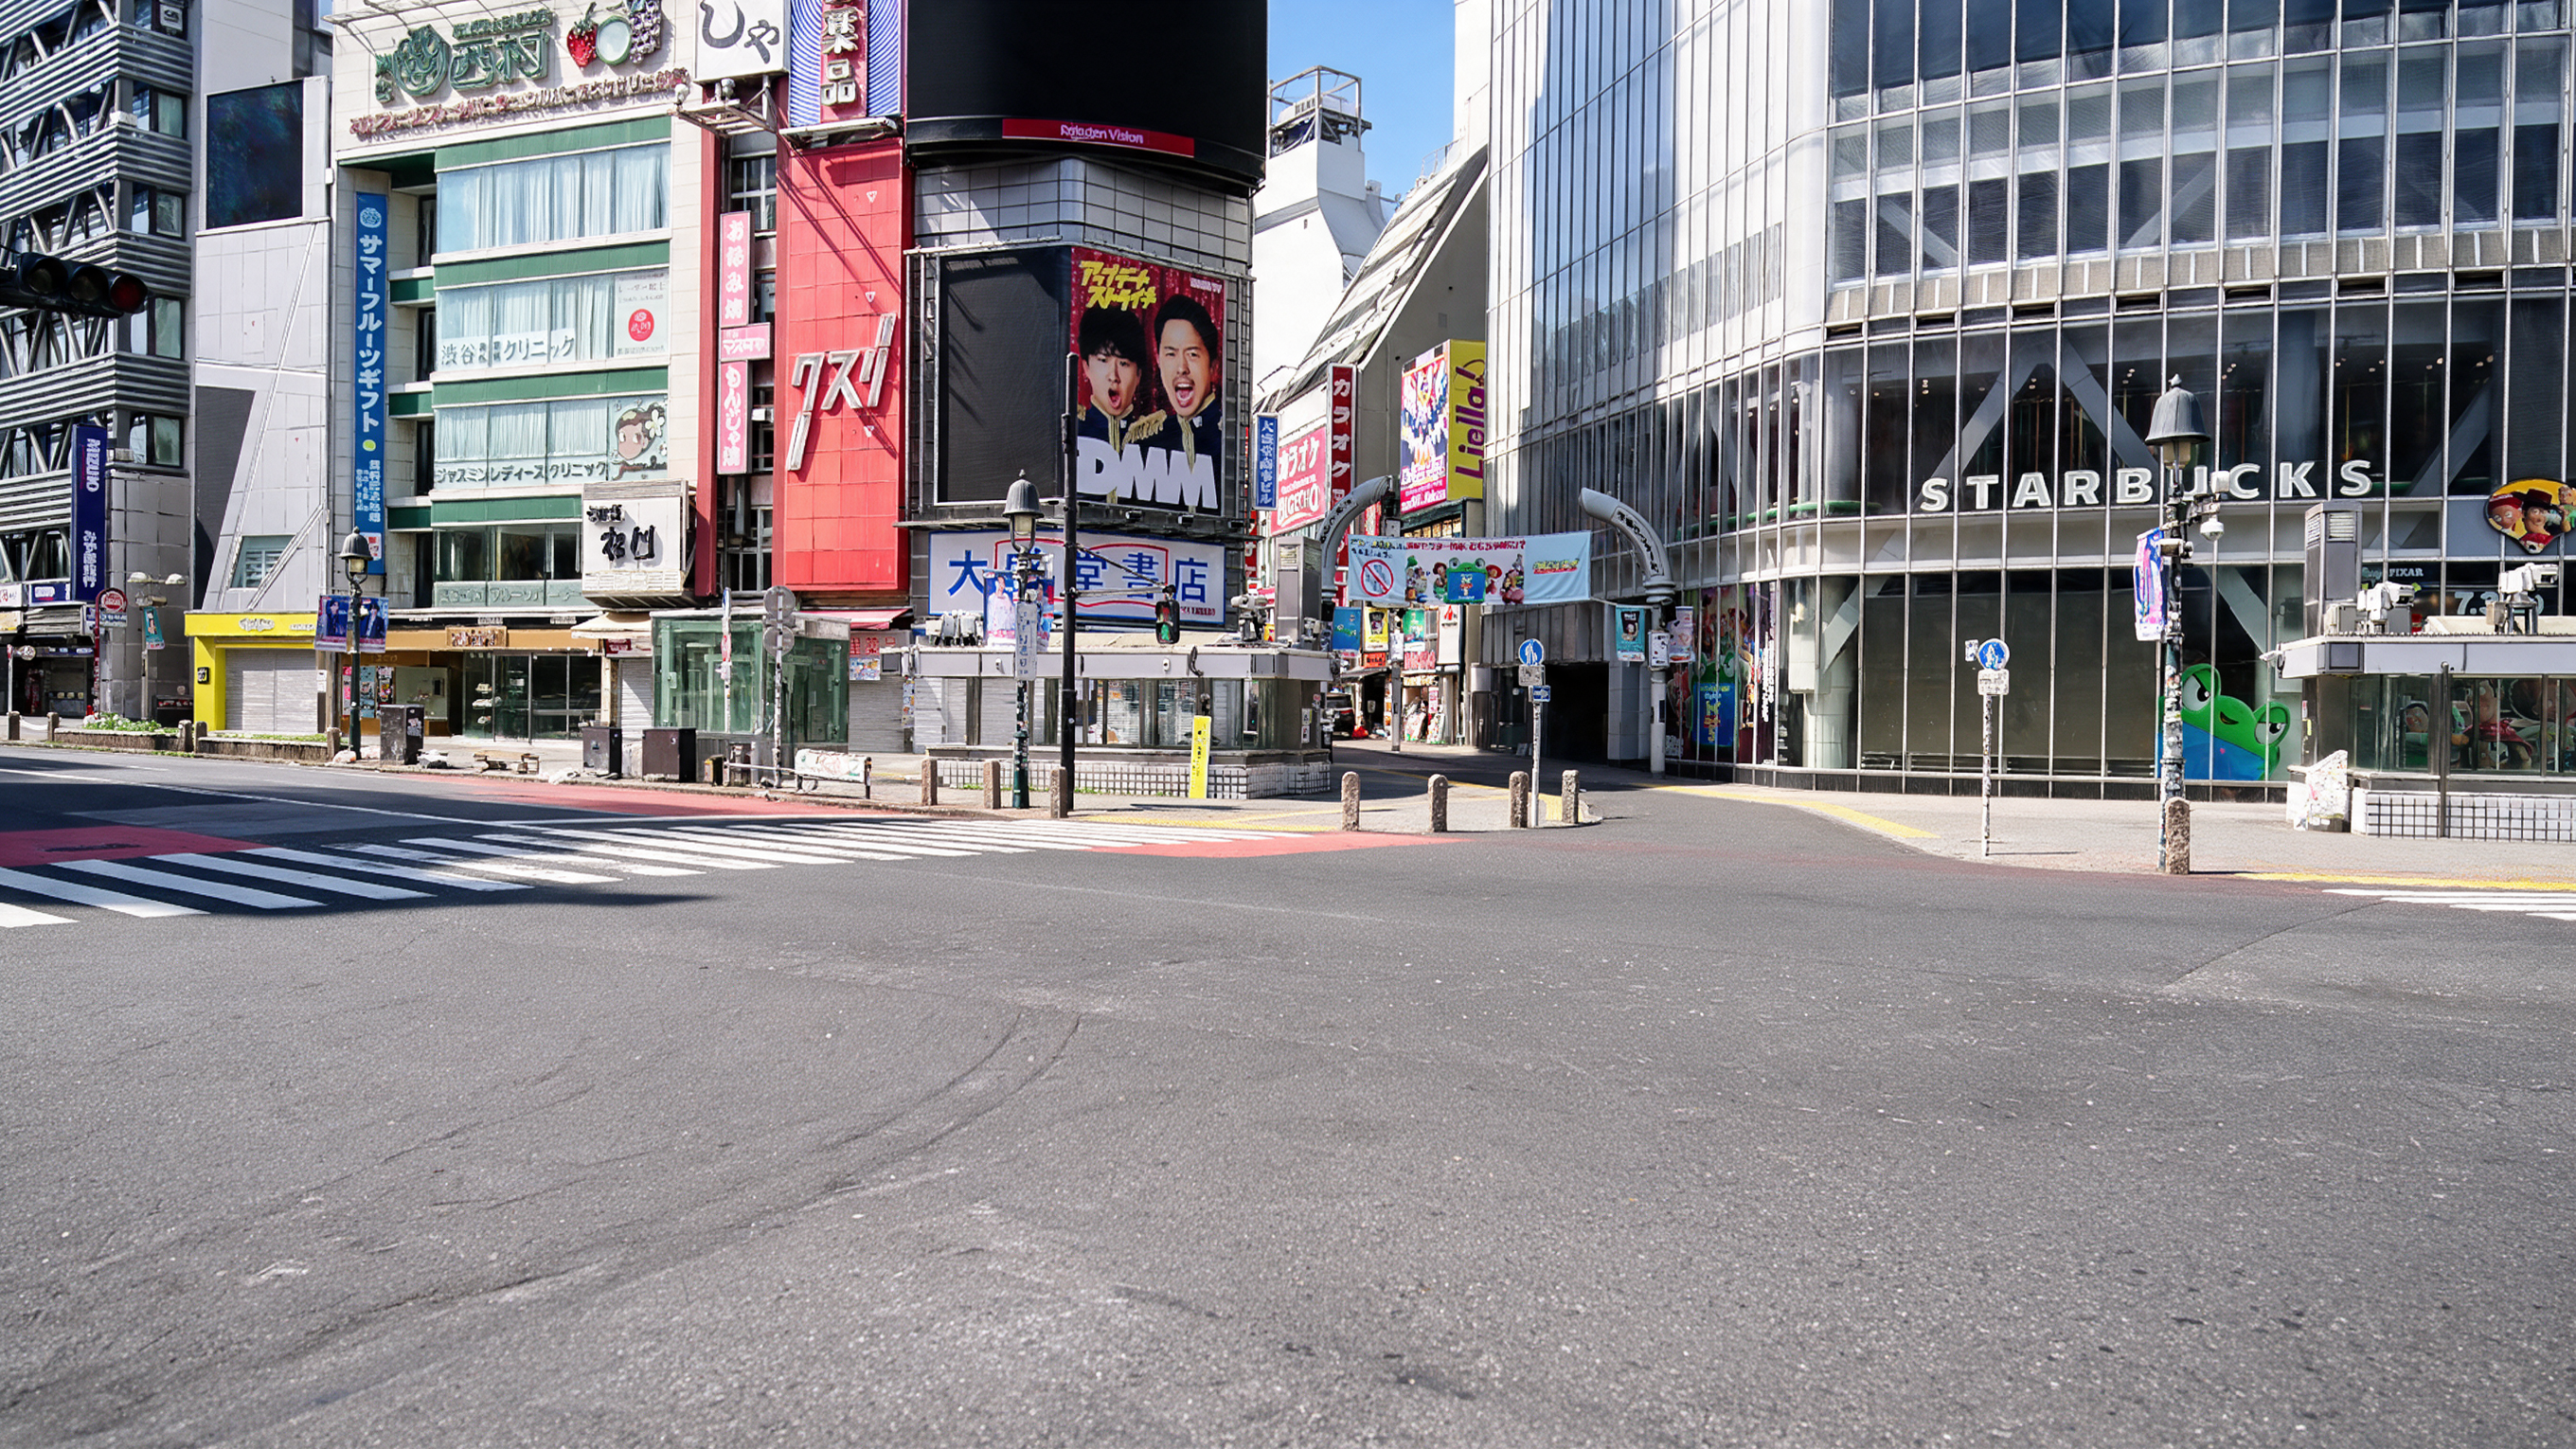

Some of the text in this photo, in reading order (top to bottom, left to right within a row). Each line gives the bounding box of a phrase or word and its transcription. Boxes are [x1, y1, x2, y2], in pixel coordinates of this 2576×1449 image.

[821, 0, 860, 105] 薬品
[1108, 129, 1144, 144] Vision
[358, 235, 383, 433] サマーフルーツギフト
[786, 313, 897, 472] クスリ
[1455, 366, 1486, 480] Liella!
[1077, 436, 1218, 509] DMM
[1279, 436, 1320, 482] カラオケ
[1921, 458, 2372, 511] STARBUCKS
[2388, 567, 2424, 578] PIXAR
